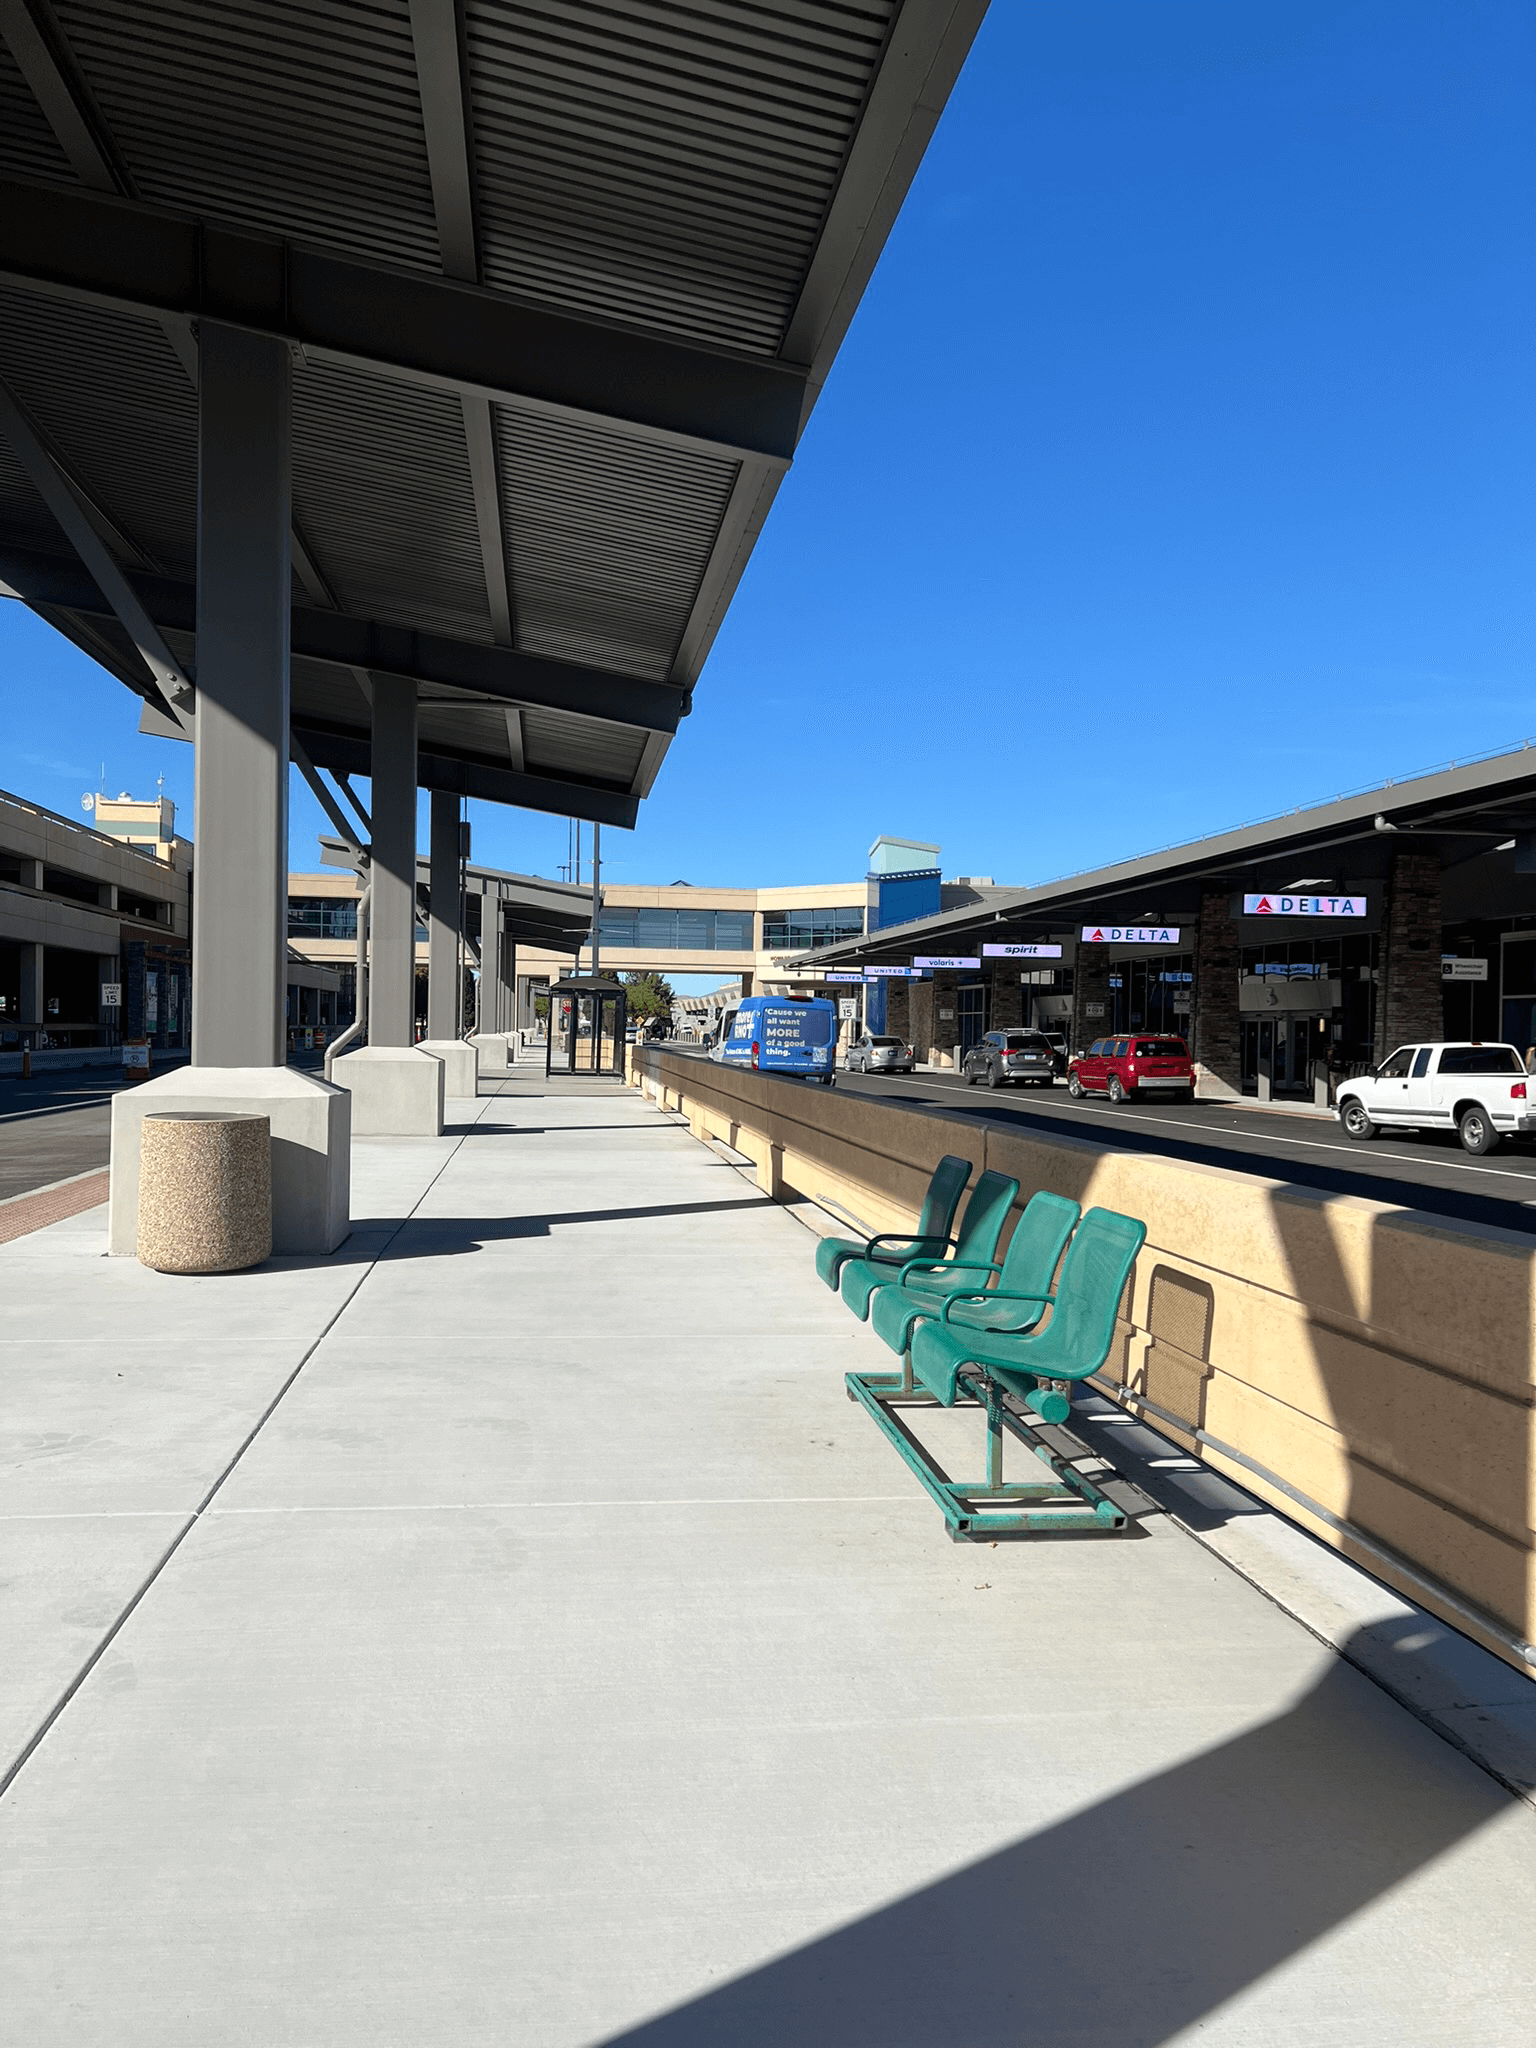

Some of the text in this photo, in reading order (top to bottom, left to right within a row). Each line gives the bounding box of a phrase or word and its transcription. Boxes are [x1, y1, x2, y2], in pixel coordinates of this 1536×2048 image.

[1281, 898, 1354, 914] DELTA
[1111, 928, 1170, 941] DELTA
[1004, 945, 1038, 954] spirit
[106, 995, 117, 1004] 15
[1266, 986, 1279, 1006] 3
[843, 1009, 853, 1017] 15
[766, 1028, 800, 1037] MORE
[784, 1040, 805, 1048] good
[766, 1048, 791, 1056] thing.
